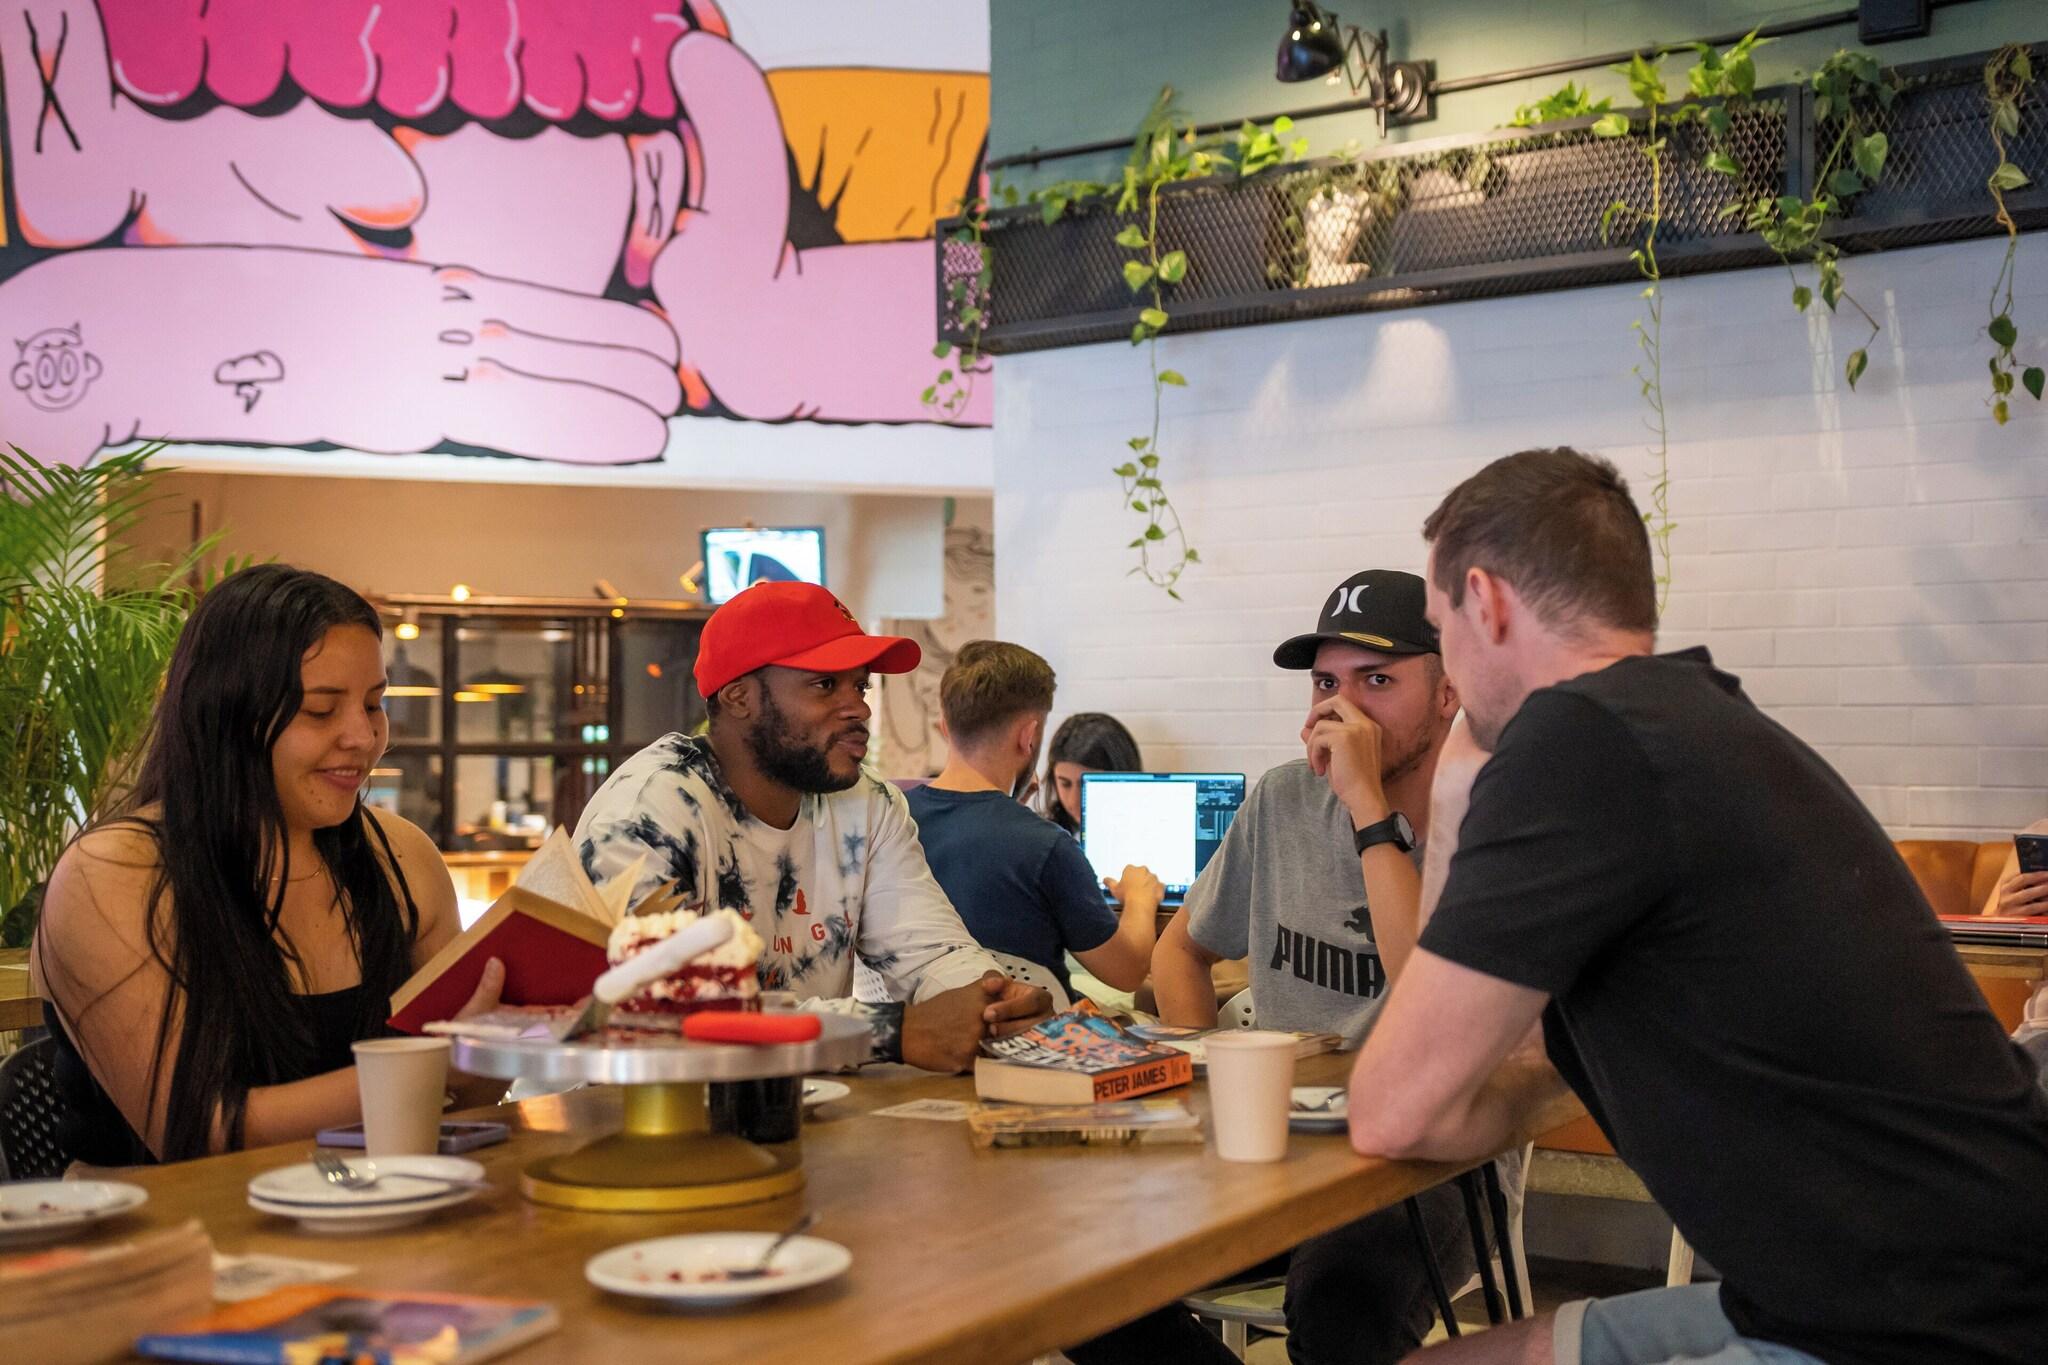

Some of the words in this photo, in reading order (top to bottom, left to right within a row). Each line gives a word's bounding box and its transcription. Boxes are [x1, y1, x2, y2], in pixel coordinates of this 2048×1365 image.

[1270, 922, 1386, 999] PUMA
[1094, 1075, 1129, 1101] PETER
[1131, 1065, 1167, 1089] JAMES
